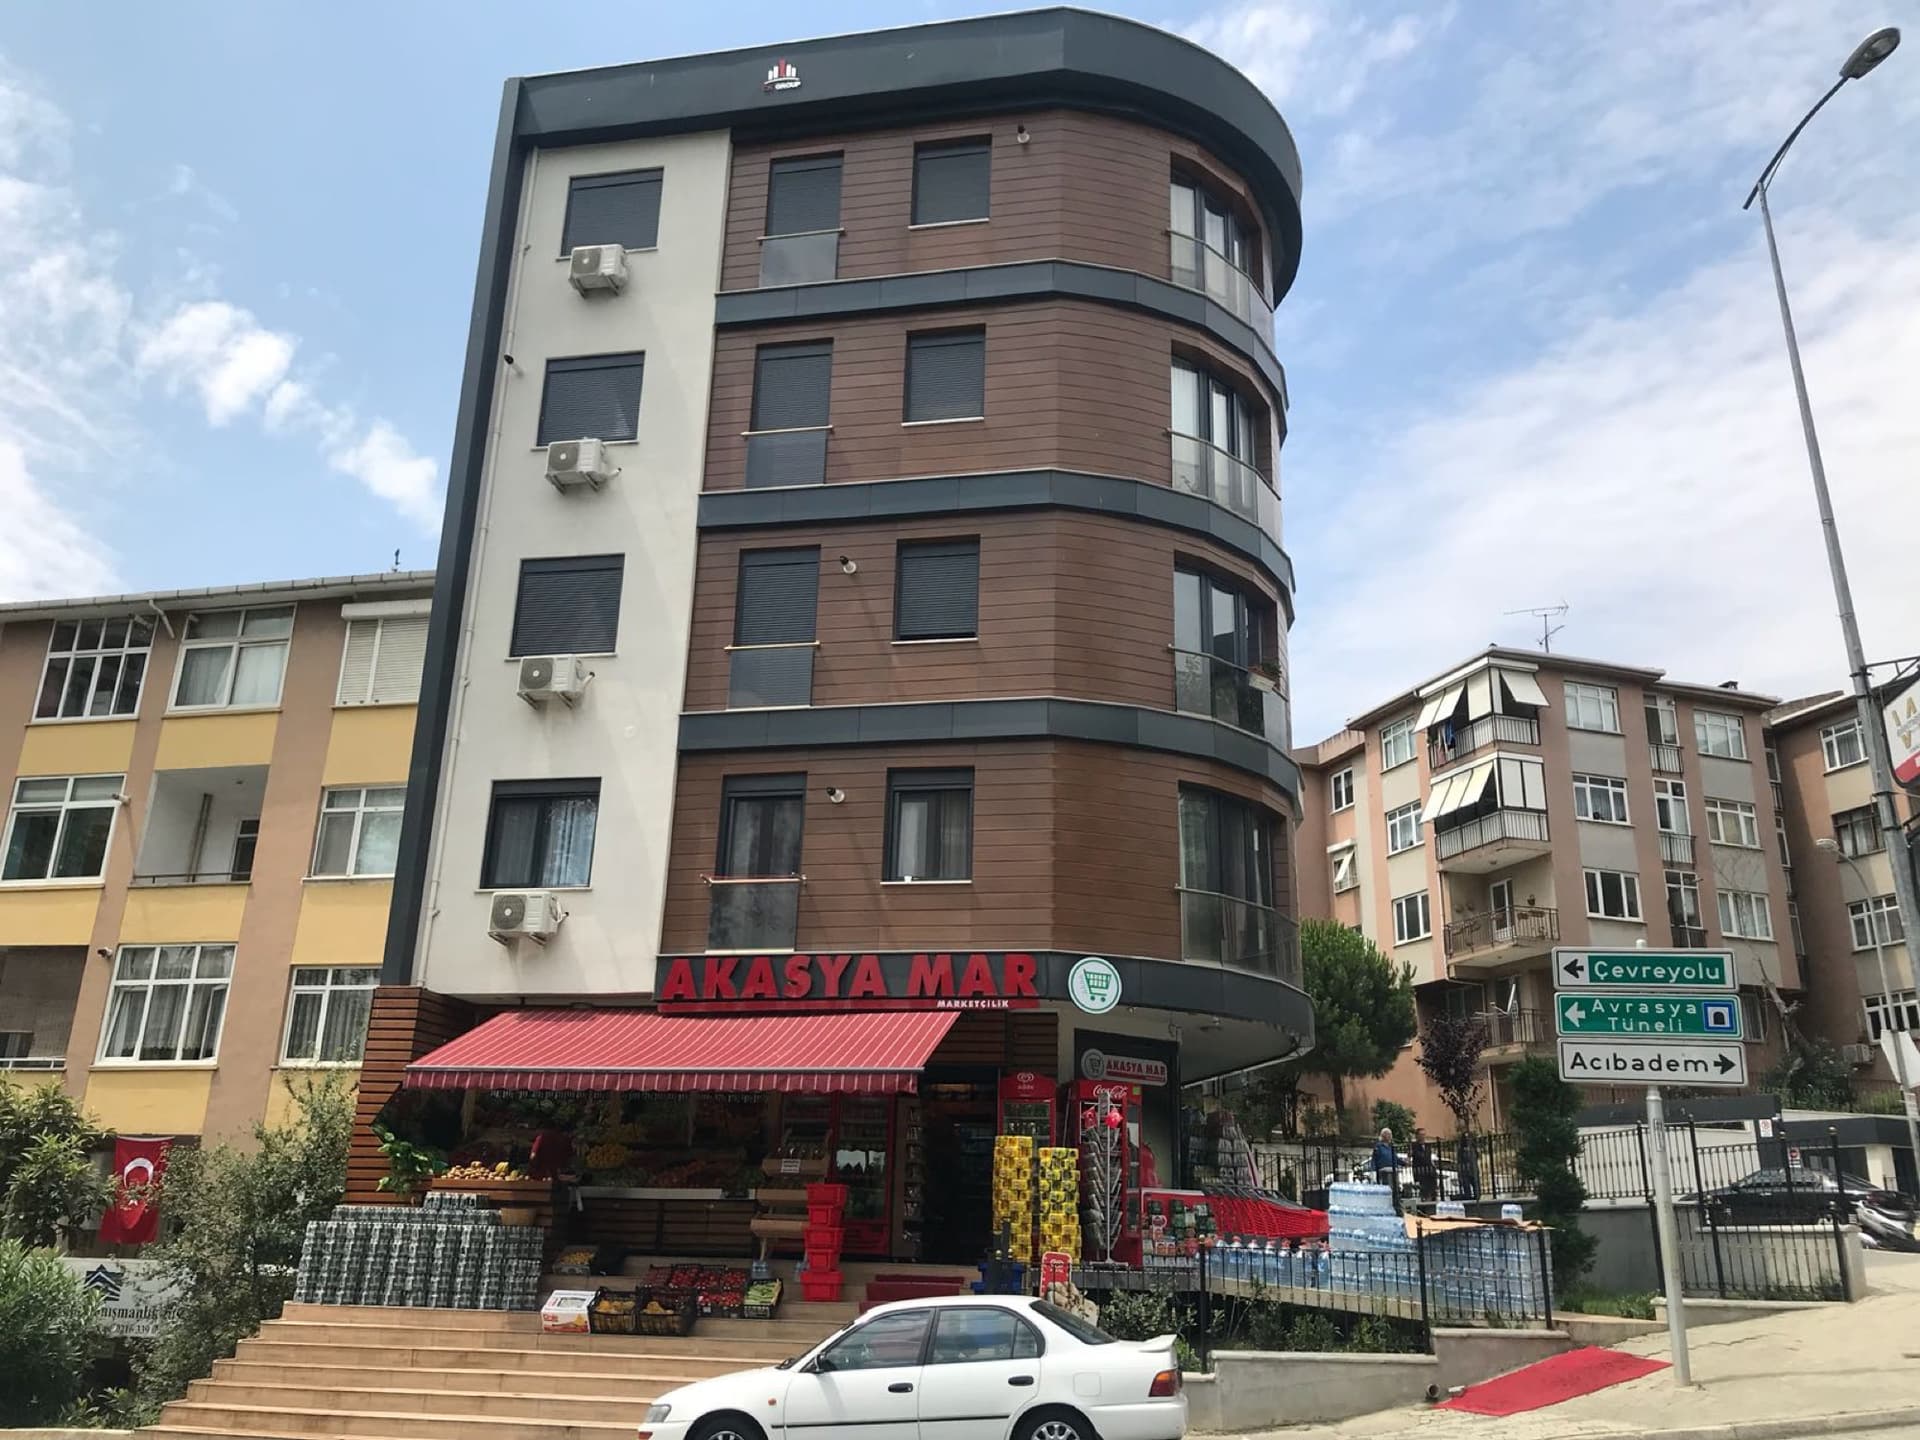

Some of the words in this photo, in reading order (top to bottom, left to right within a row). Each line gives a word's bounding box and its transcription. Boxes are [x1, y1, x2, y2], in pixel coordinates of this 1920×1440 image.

[662, 955, 888, 1000] AKASYA
[906, 953, 1039, 998] MAR
[1594, 960, 1720, 983] Çevreyolu
[1592, 999, 1697, 1018] Avrasya
[1608, 1016, 1683, 1032] Tüneli
[1106, 1059, 1143, 1073] AKASYA
[1570, 1051, 1709, 1073] Acıbadem
